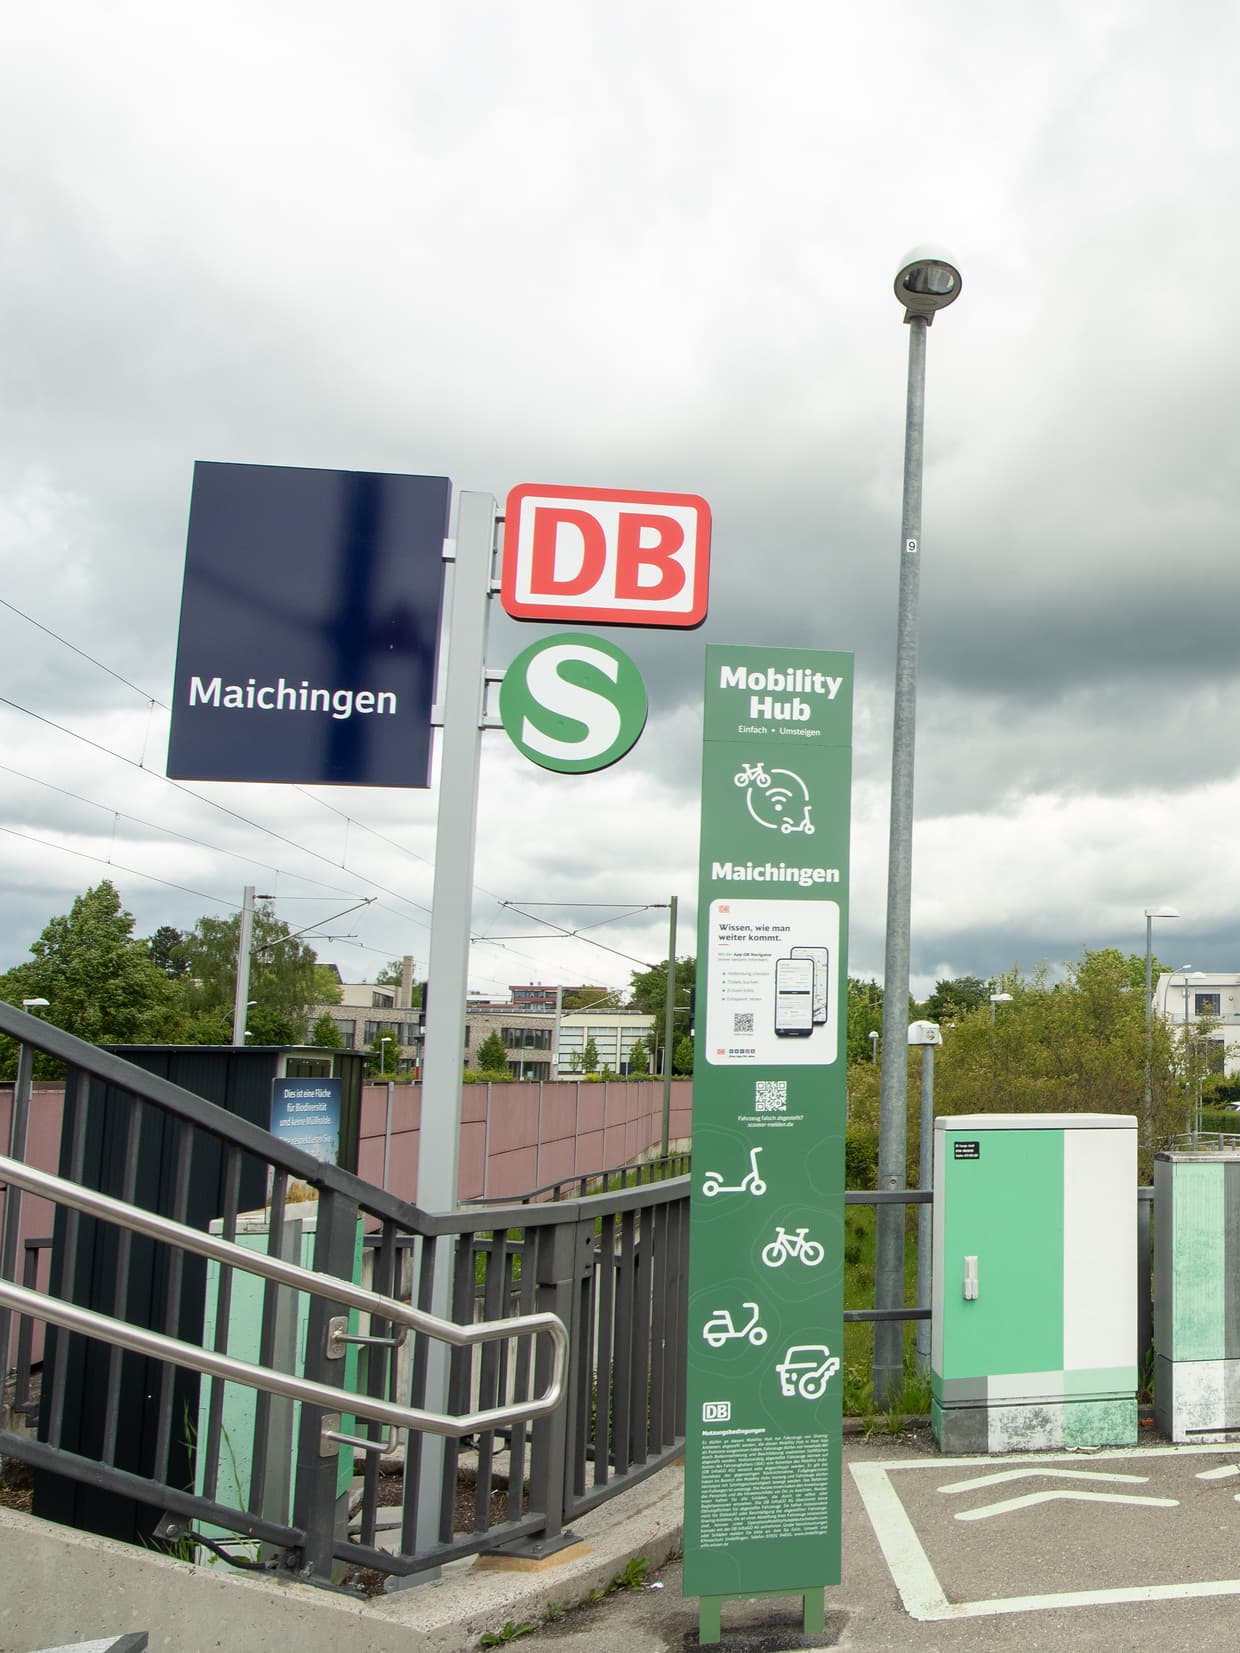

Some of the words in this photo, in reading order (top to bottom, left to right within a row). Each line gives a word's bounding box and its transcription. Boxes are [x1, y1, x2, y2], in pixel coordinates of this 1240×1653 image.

[530, 506, 686, 601] DB
[908, 541, 916, 551] 9
[719, 665, 843, 700] Mobility
[188, 675, 398, 720] Maichingen
[522, 644, 621, 761] S
[749, 695, 811, 721] Hub
[738, 725, 768, 734] Einfach
[779, 727, 821, 737] Umsteigen
[711, 861, 840, 887] Maichingen
[718, 923, 753, 932] Wissen,
[755, 924, 770, 932] wie
[718, 933, 746, 941] weiter
[748, 934, 782, 942] kommt.
[706, 1405, 728, 1419] DB
